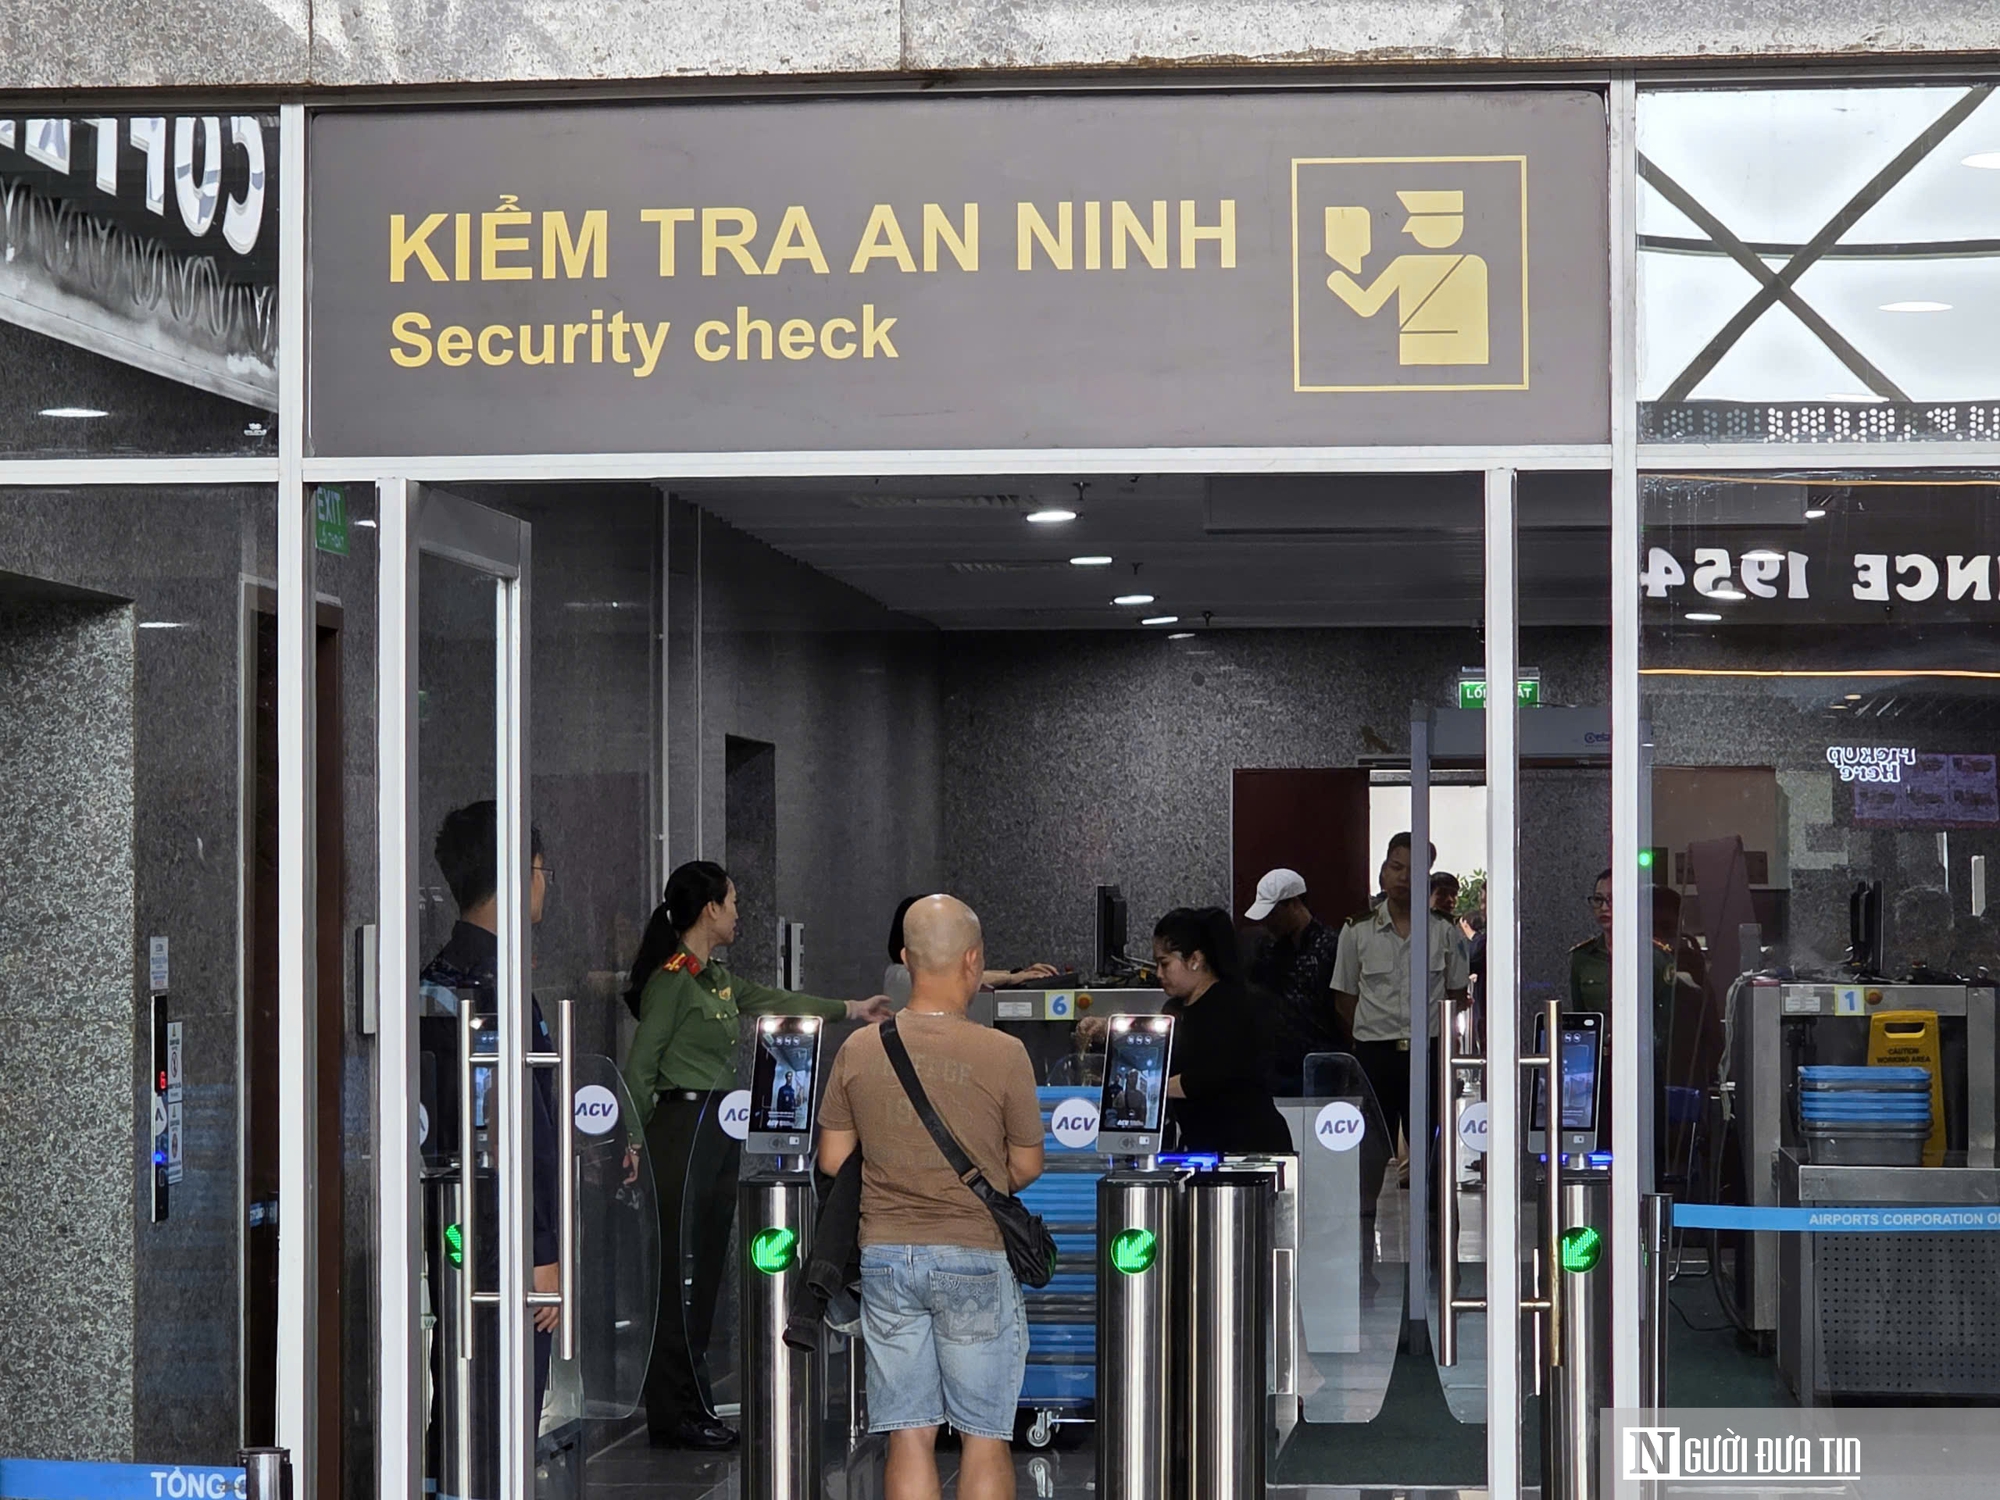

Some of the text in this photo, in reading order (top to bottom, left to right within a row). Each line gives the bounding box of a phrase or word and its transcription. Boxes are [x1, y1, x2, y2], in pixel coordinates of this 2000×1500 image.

[390, 195, 1237, 282] KIỂM TRA AN NINH
[390, 304, 899, 377] Security check
[317, 486, 340, 525] EXIT
[1052, 995, 1067, 1016] 6
[1844, 991, 1855, 1011] 1
[1887, 1047, 1920, 1055] CAUTION
[1876, 1055, 1932, 1064] WORKING AREA
[575, 1102, 614, 1117] ACV
[724, 1108, 749, 1122] AC
[1056, 1116, 1097, 1131] ACV
[1320, 1119, 1360, 1134] ACV
[1463, 1119, 1488, 1134] AC
[1809, 1212, 2000, 1225] AIRPORTS CORPORATION O
